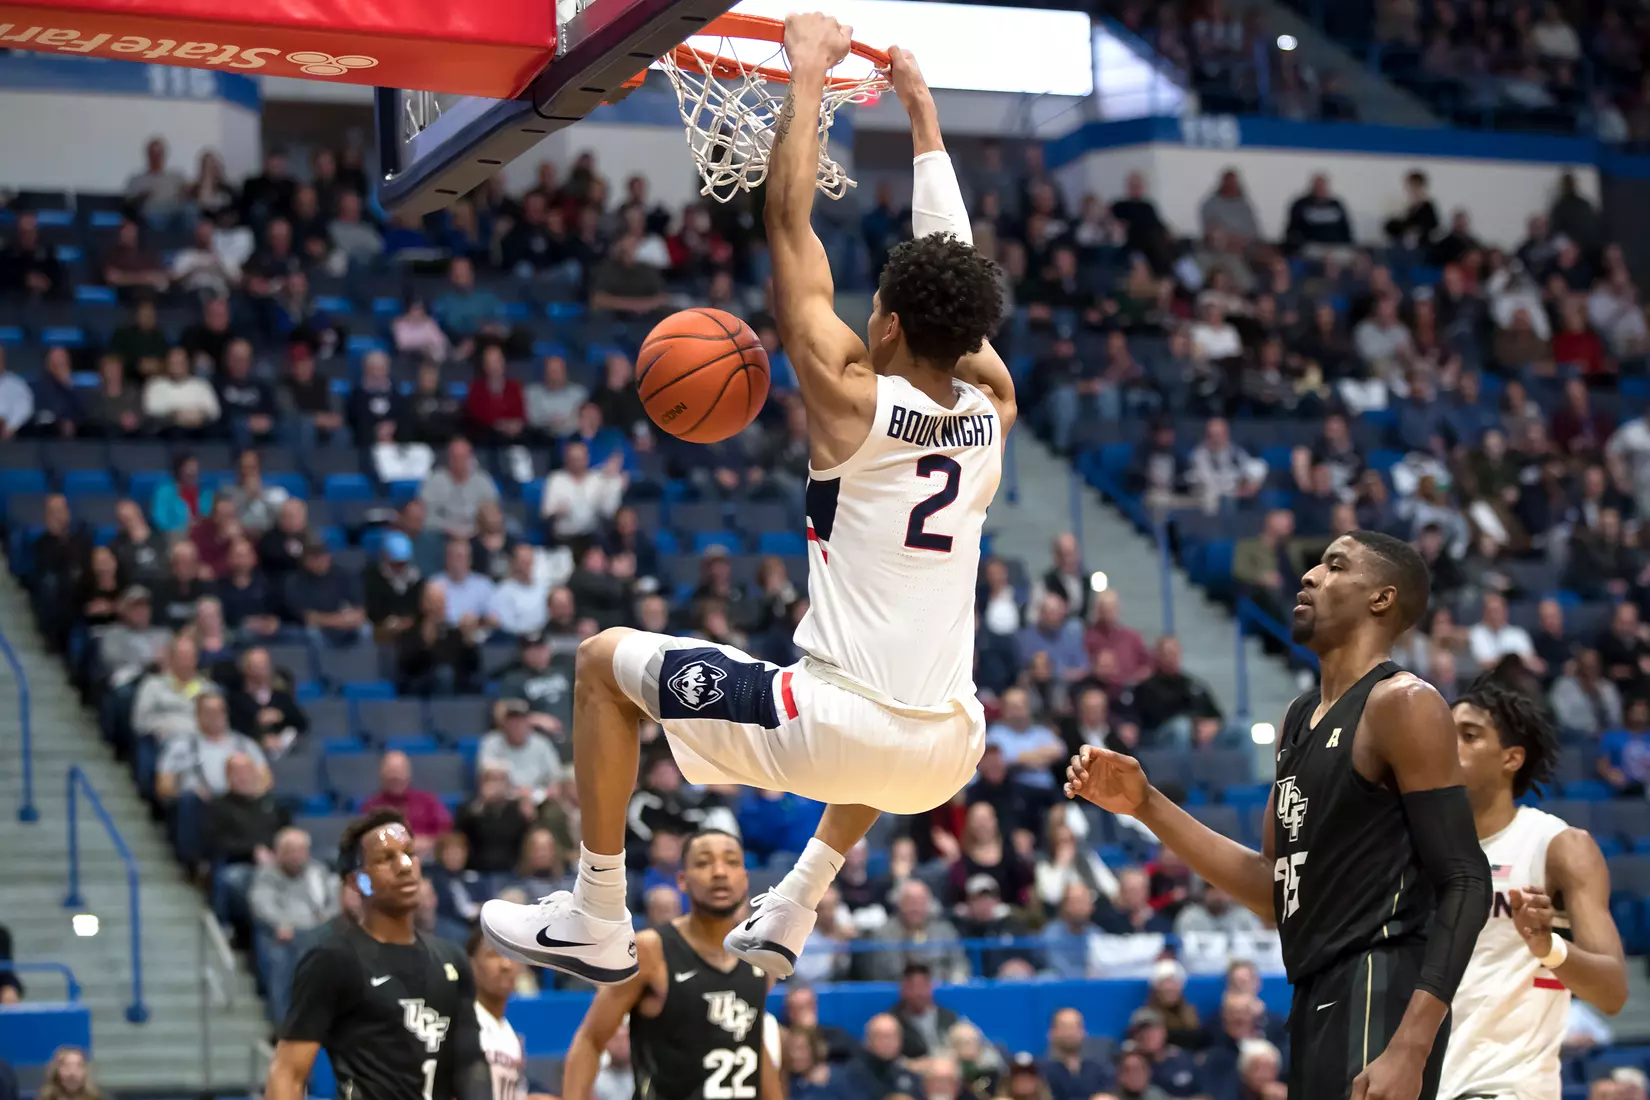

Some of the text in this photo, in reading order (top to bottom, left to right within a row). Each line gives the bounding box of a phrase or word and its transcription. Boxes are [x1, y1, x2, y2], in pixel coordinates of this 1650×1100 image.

[887, 405, 993, 447] BOUKNIGHT
[904, 454, 962, 552] 2
[1277, 775, 1309, 842] UCF
[398, 998, 451, 1053] UCF
[703, 990, 758, 1042] UCF
[421, 1059, 438, 1100] 1
[702, 1045, 758, 1100] 22
